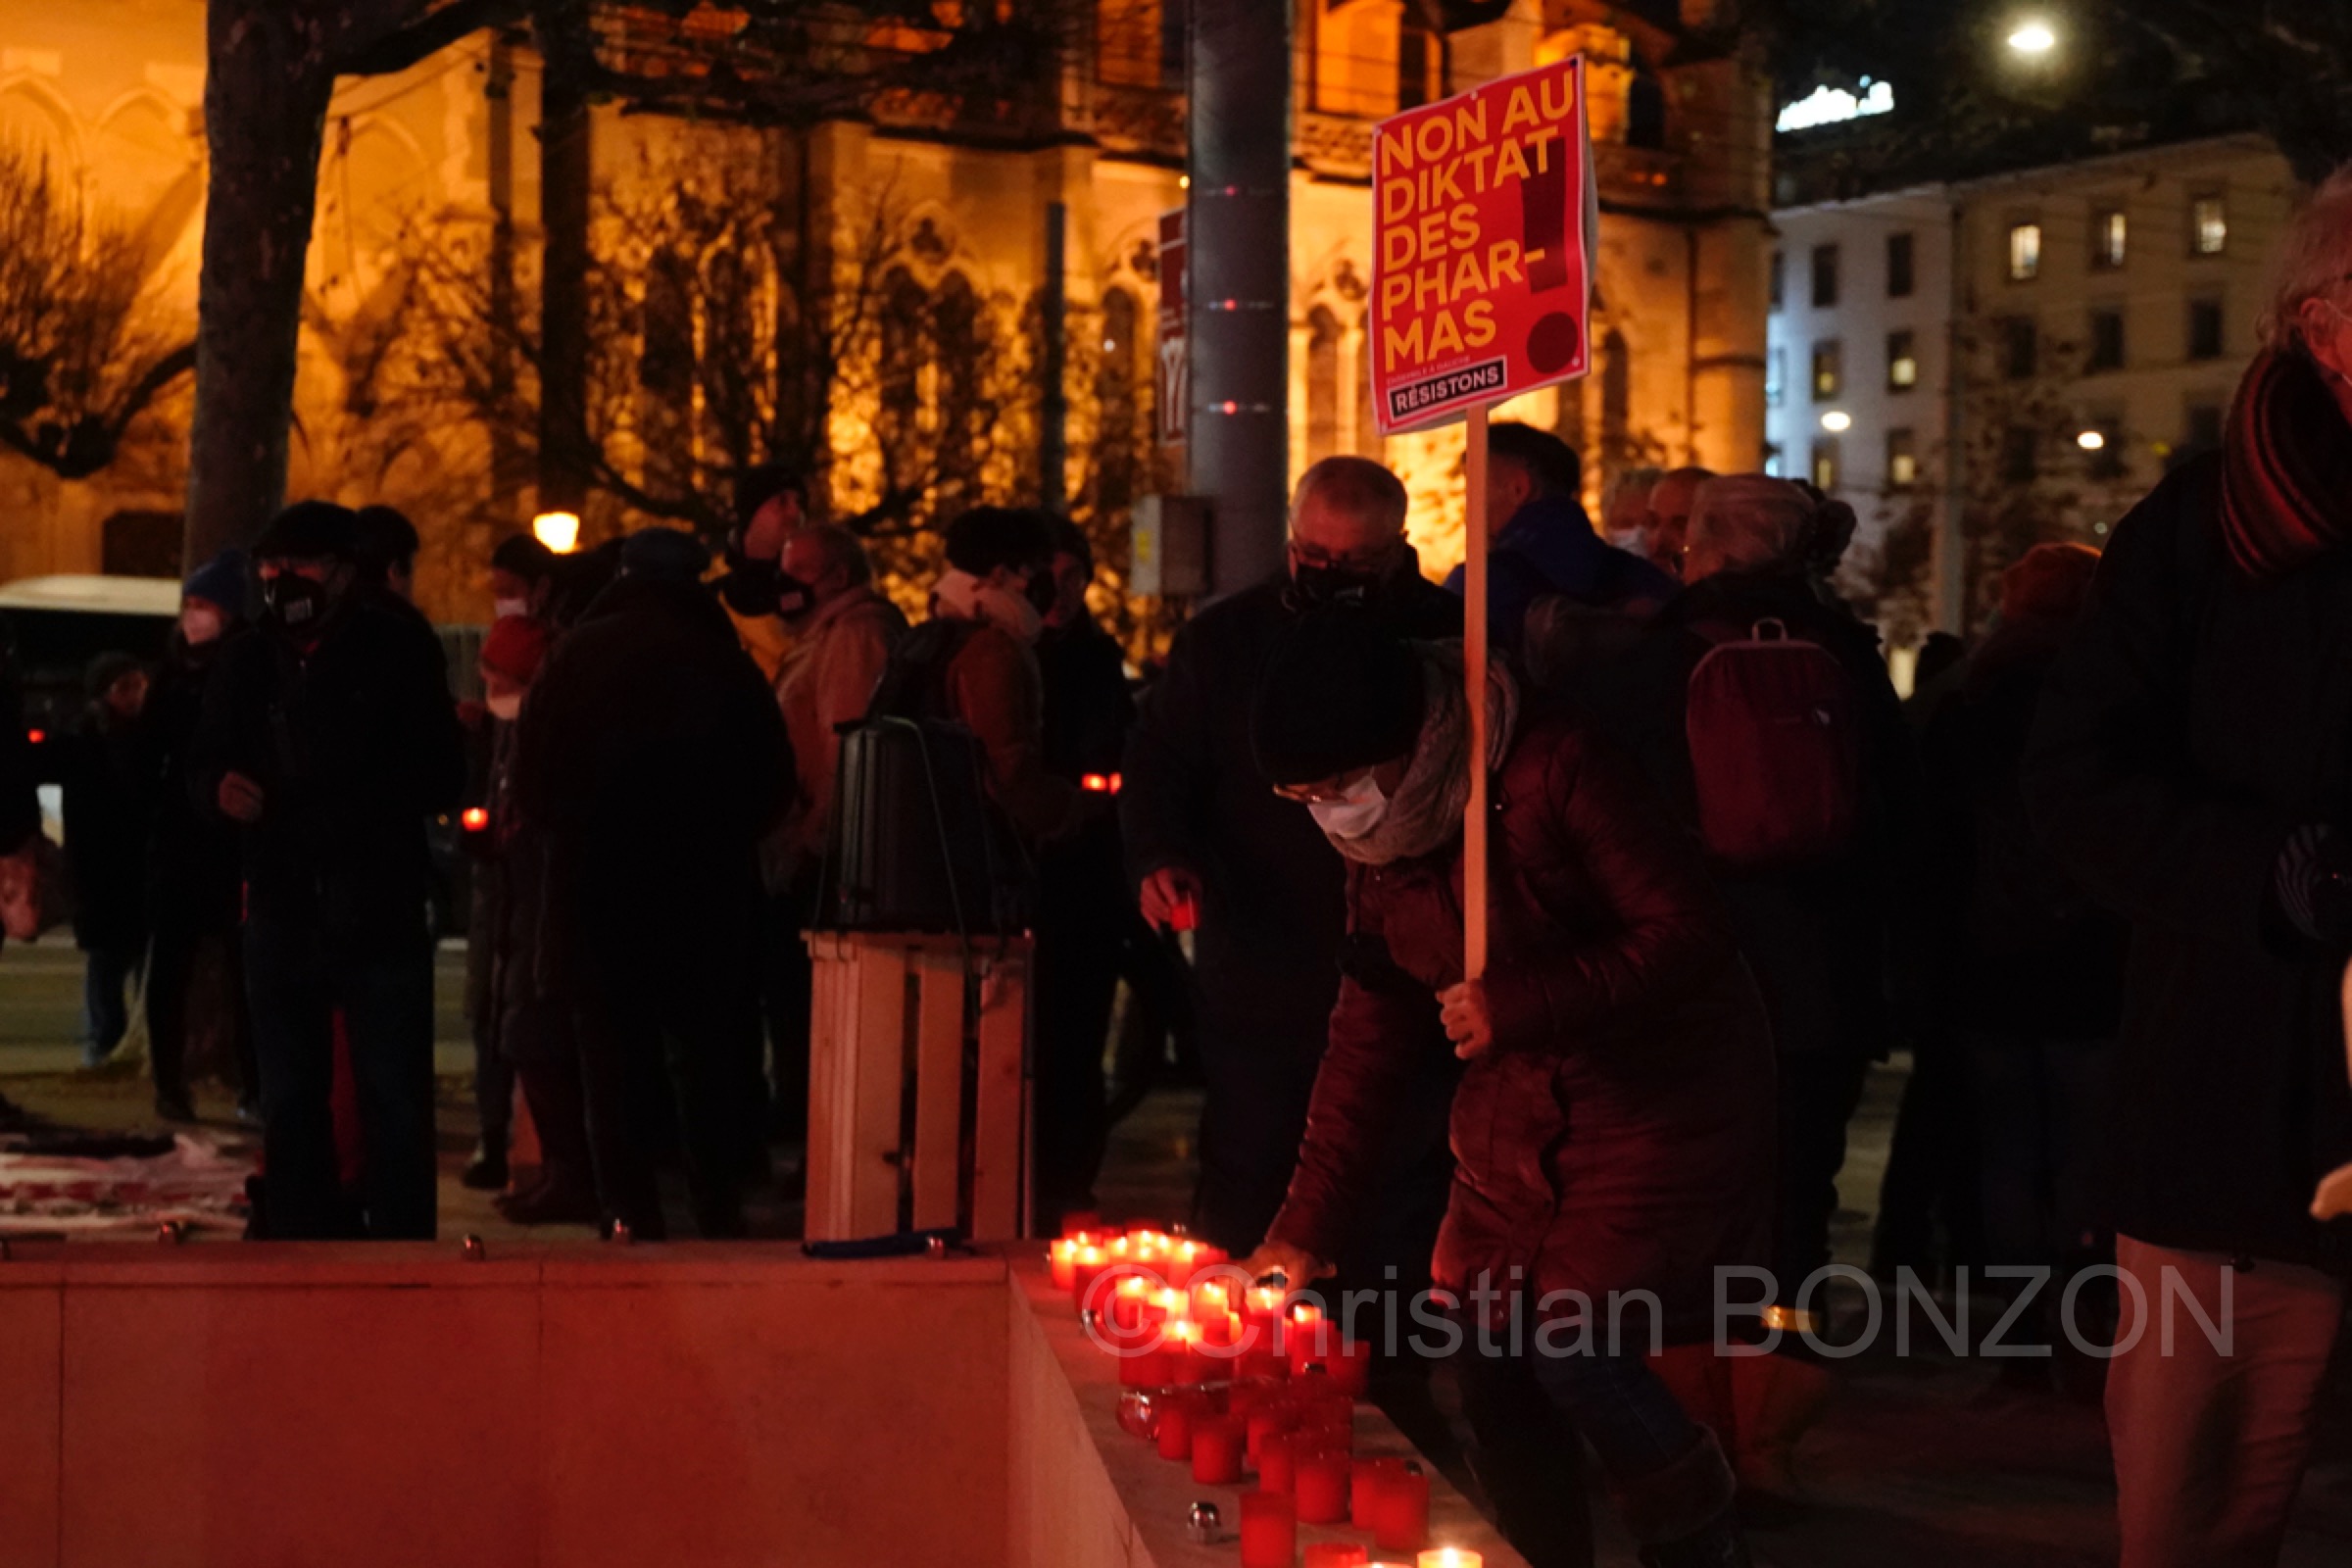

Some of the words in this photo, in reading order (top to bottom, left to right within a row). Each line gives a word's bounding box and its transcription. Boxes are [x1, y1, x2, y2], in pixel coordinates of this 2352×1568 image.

[1381, 98, 1487, 177] NON
[1501, 71, 1574, 135] AU
[1383, 125, 1558, 226] DIKTAT
[1383, 202, 1481, 273] DES
[1382, 239, 1545, 322] PHAR-
[1384, 299, 1496, 372] MAS
[1396, 365, 1499, 414] RÉSISTONS
